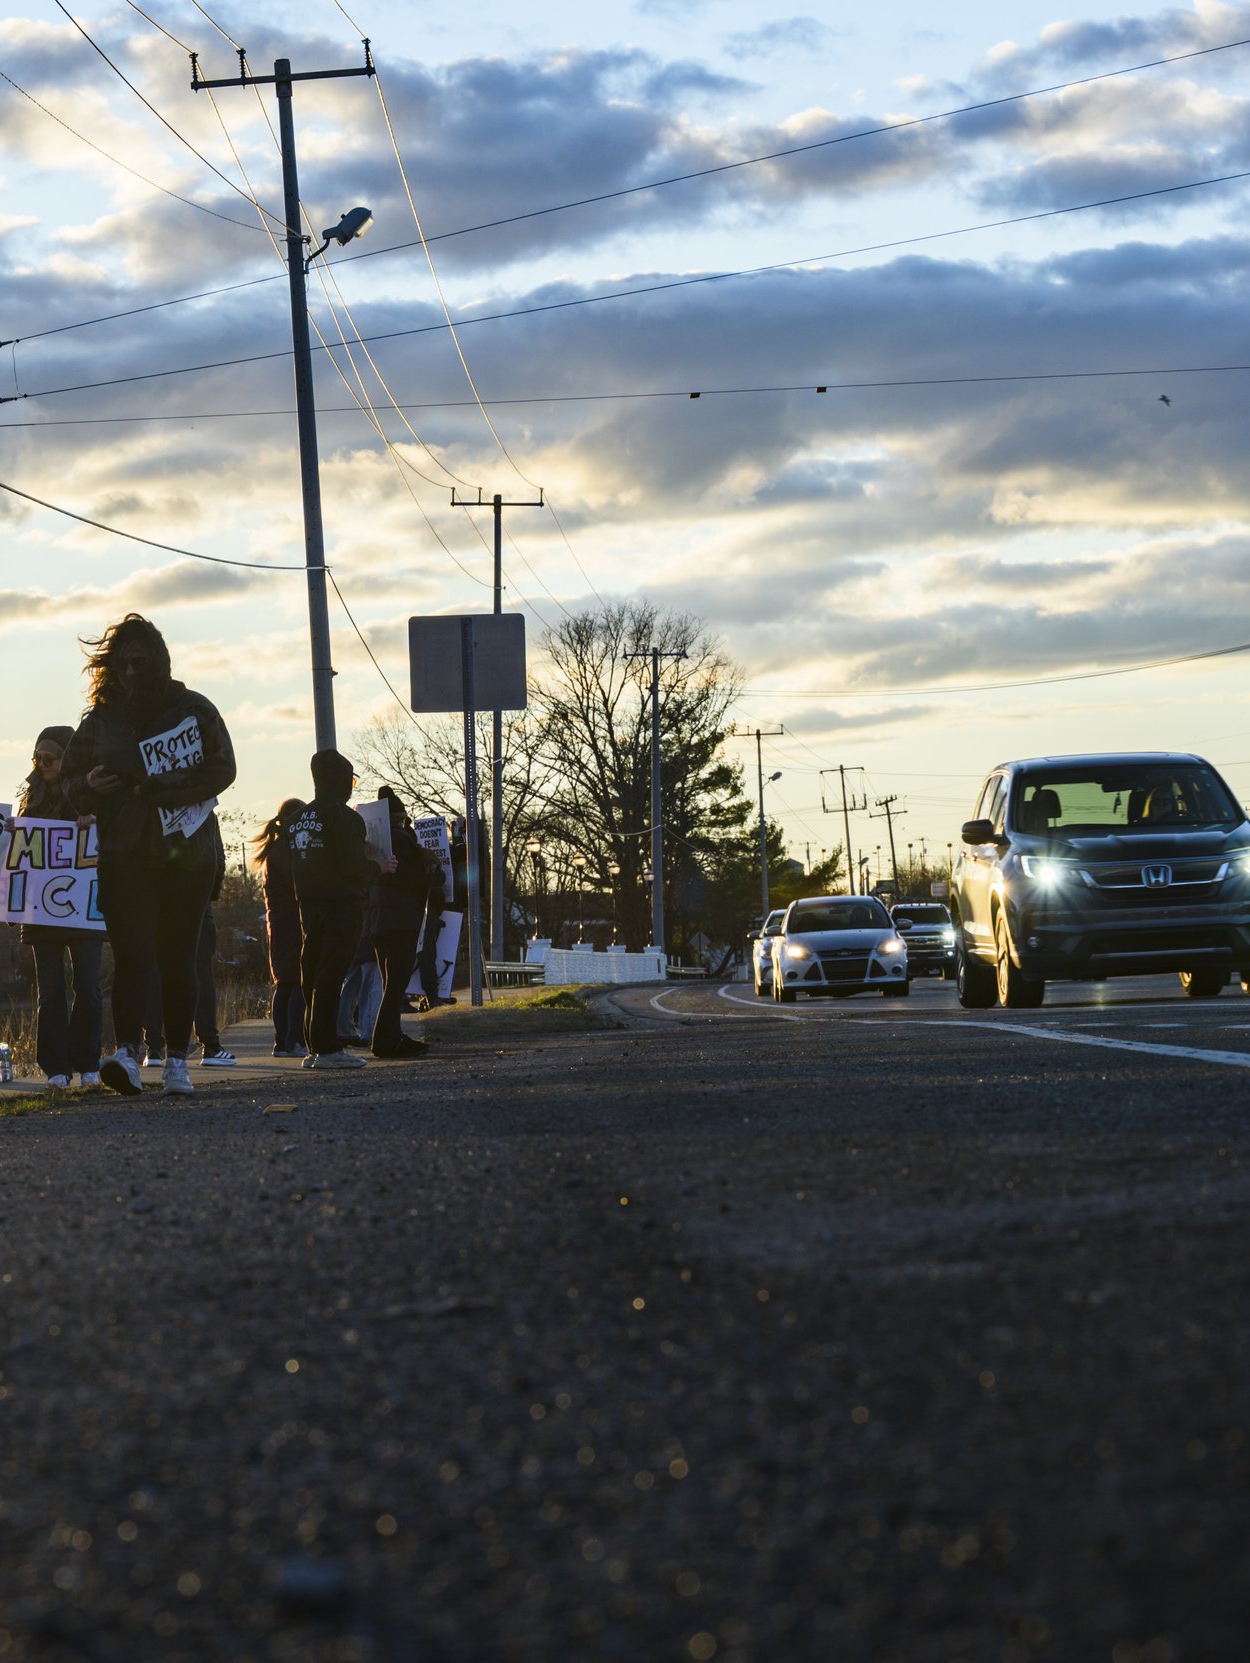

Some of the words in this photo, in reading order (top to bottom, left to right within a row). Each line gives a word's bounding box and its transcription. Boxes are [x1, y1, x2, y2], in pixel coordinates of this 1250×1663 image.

[143, 724, 201, 767] PROTEC
[290, 820, 323, 833] GOODS
[414, 818, 445, 830] DEMOCRACY
[6, 826, 99, 871] MEL
[424, 839, 439, 849] FEAR
